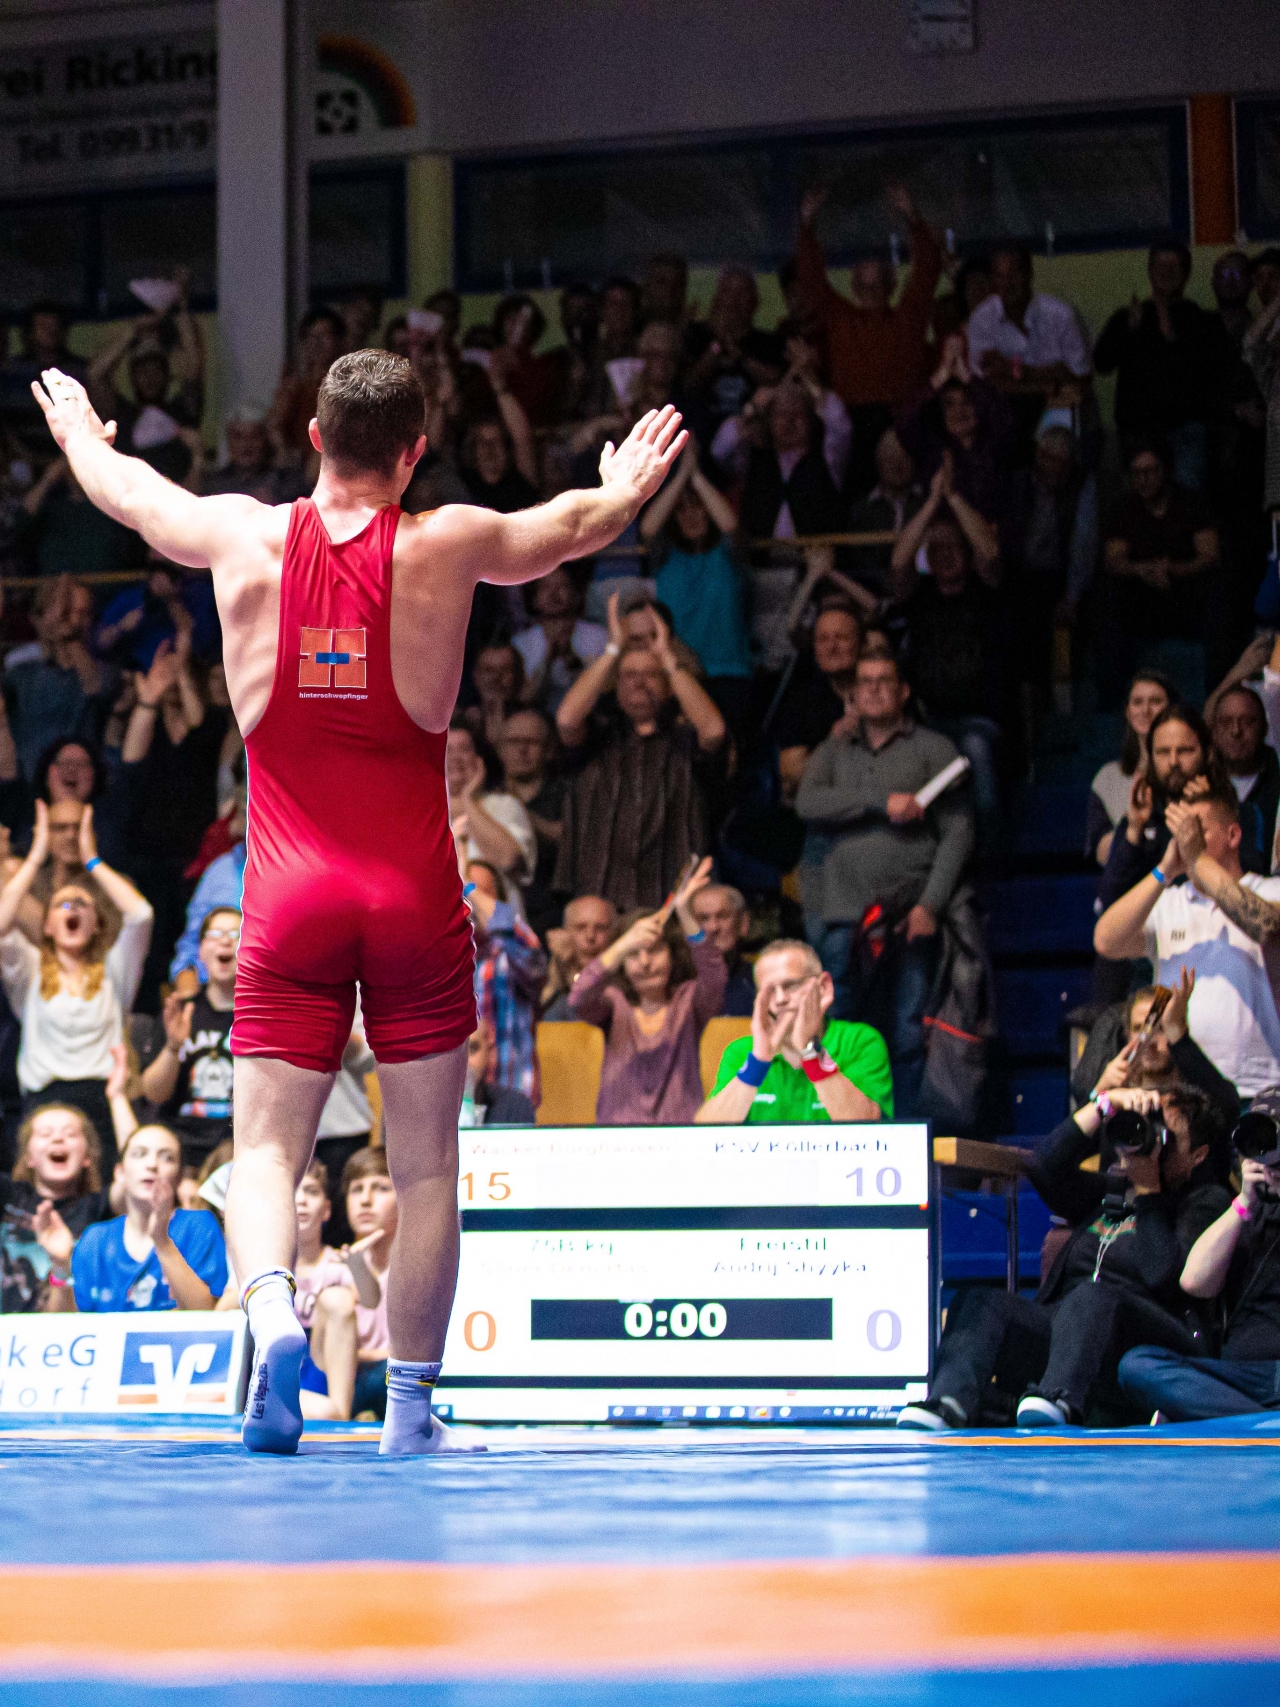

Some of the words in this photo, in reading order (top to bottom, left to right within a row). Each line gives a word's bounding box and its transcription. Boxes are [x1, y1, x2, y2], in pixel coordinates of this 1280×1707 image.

[714, 1140, 761, 1154] KSV
[459, 1171, 513, 1201] 15
[844, 1166, 903, 1198] 10
[463, 1310, 497, 1352] 0
[624, 1302, 728, 1338] 0:00
[865, 1309, 903, 1352] 0
[42, 1334, 98, 1368] eG
